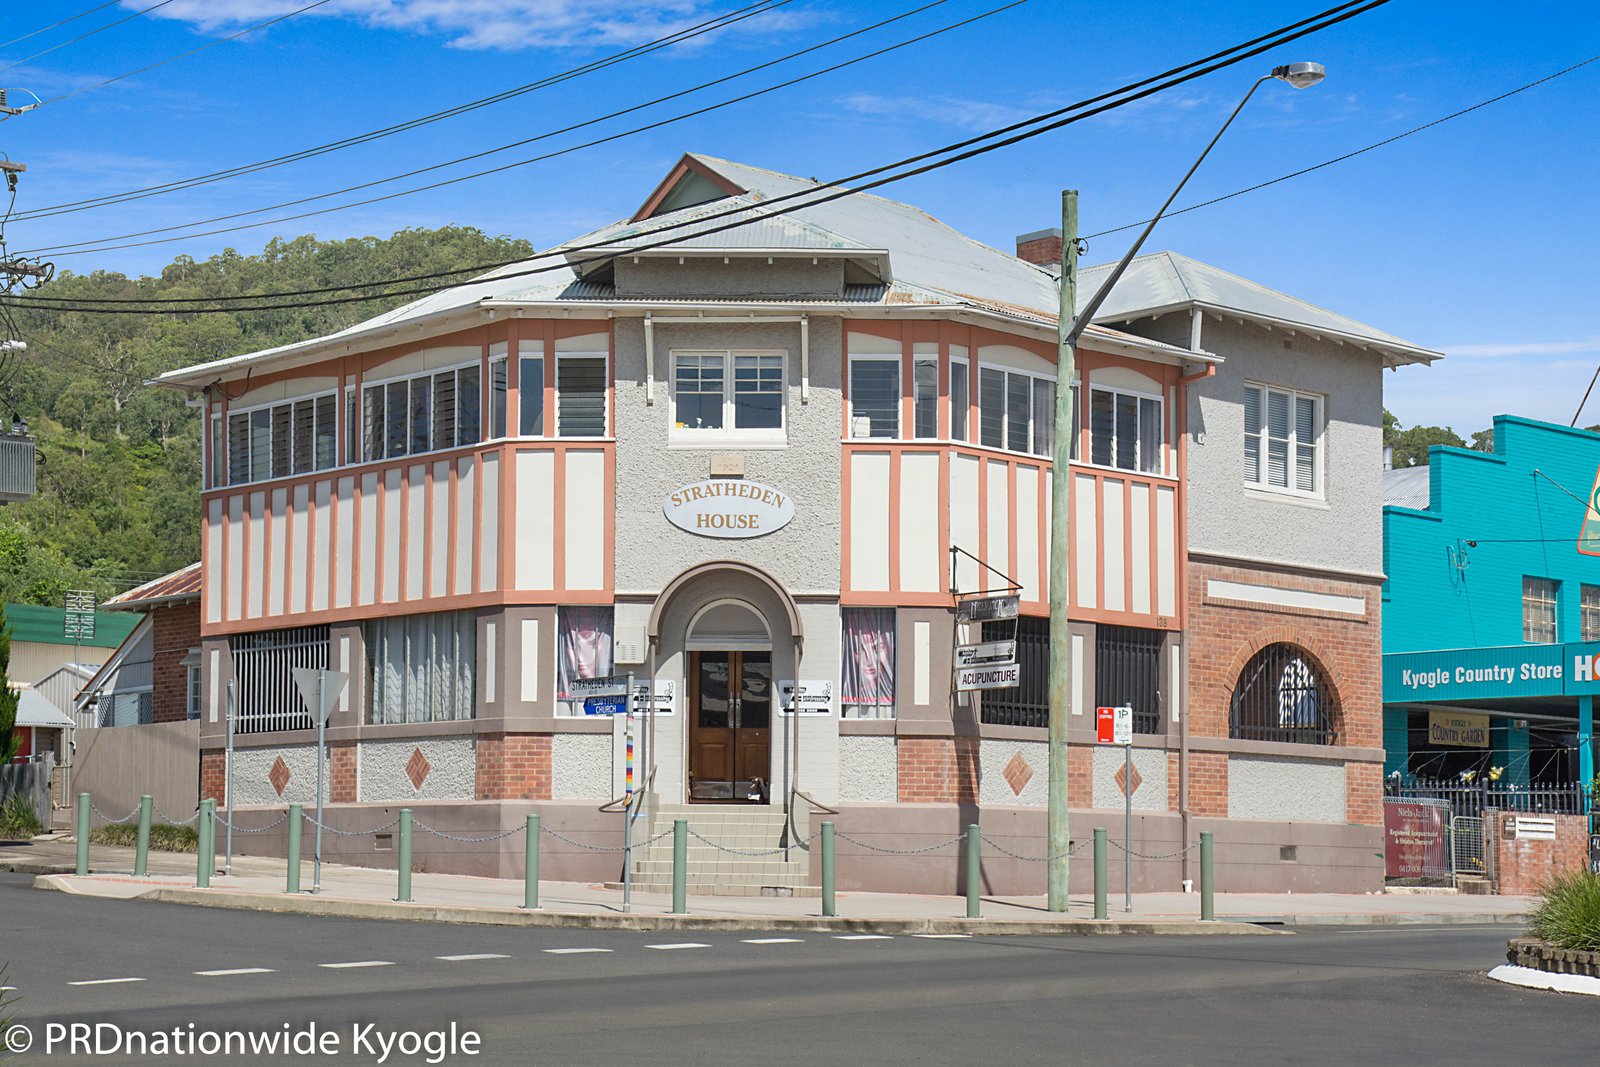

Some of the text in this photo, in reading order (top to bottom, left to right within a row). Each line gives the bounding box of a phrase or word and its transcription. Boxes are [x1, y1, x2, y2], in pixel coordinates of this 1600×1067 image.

[671, 483, 785, 508] STRATHEDEN
[697, 513, 759, 529] HOUSE
[1402, 662, 1562, 689] Kyogle Country Store
[1574, 655, 1600, 681] H
[571, 678, 614, 691] STRATHEDEN ST
[962, 669, 1016, 685] ACUPUNCTURE
[587, 695, 625, 706] PRESBYTERIAN
[595, 705, 616, 714] CHURCH
[1118, 709, 1128, 719] 1P
[1432, 723, 1485, 743] COUNTRY GARDEN
